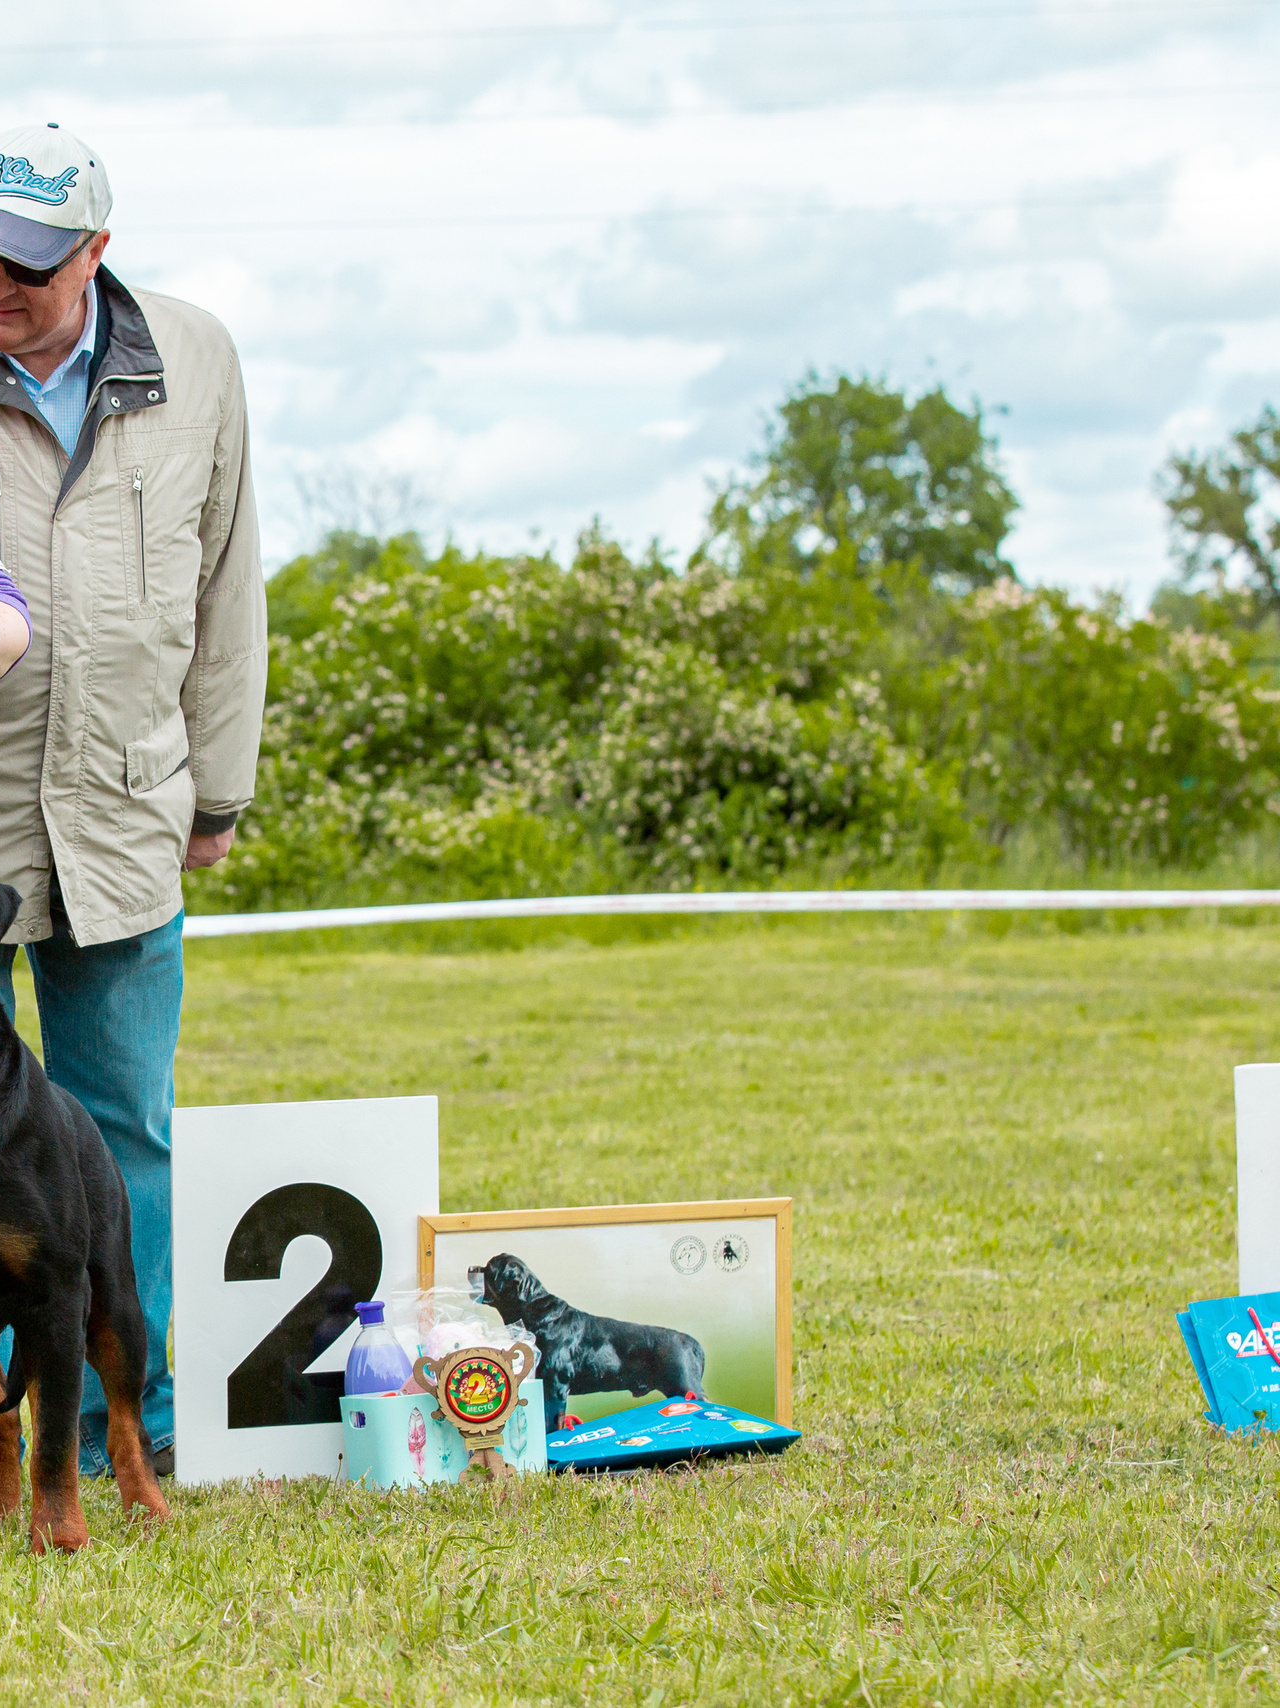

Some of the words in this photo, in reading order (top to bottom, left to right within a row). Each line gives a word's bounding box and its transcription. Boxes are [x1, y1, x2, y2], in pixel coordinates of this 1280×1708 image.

[224, 1182, 383, 1430] 2
[468, 1373, 488, 1405] 2
[466, 1403, 494, 1413] МЕСТО
